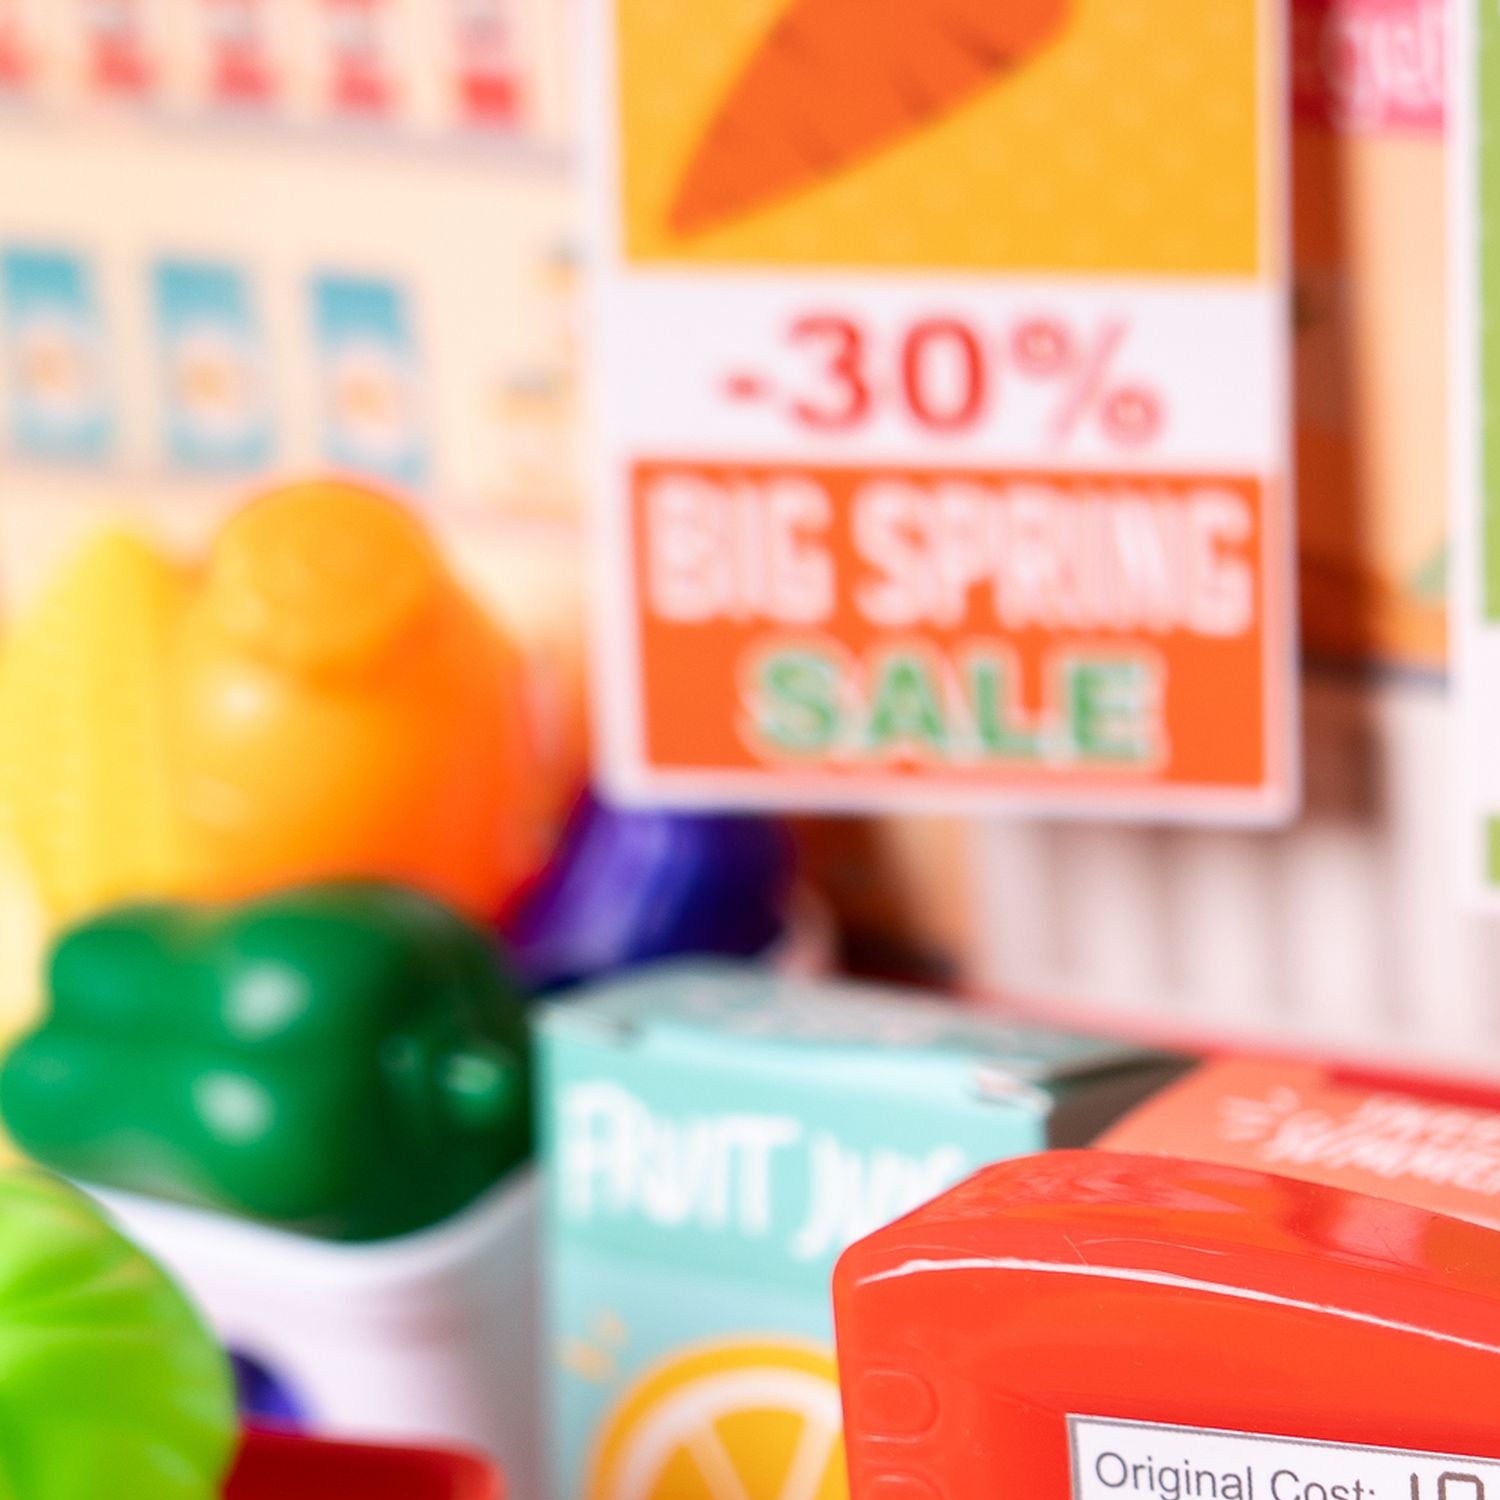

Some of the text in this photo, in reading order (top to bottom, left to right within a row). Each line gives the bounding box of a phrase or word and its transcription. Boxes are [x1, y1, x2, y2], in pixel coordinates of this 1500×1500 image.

[722, 312, 1166, 450] -30%
[647, 474, 1255, 637] BIG SPRING
[748, 640, 1158, 768] SALE
[561, 1078, 798, 1238] FRUIT
